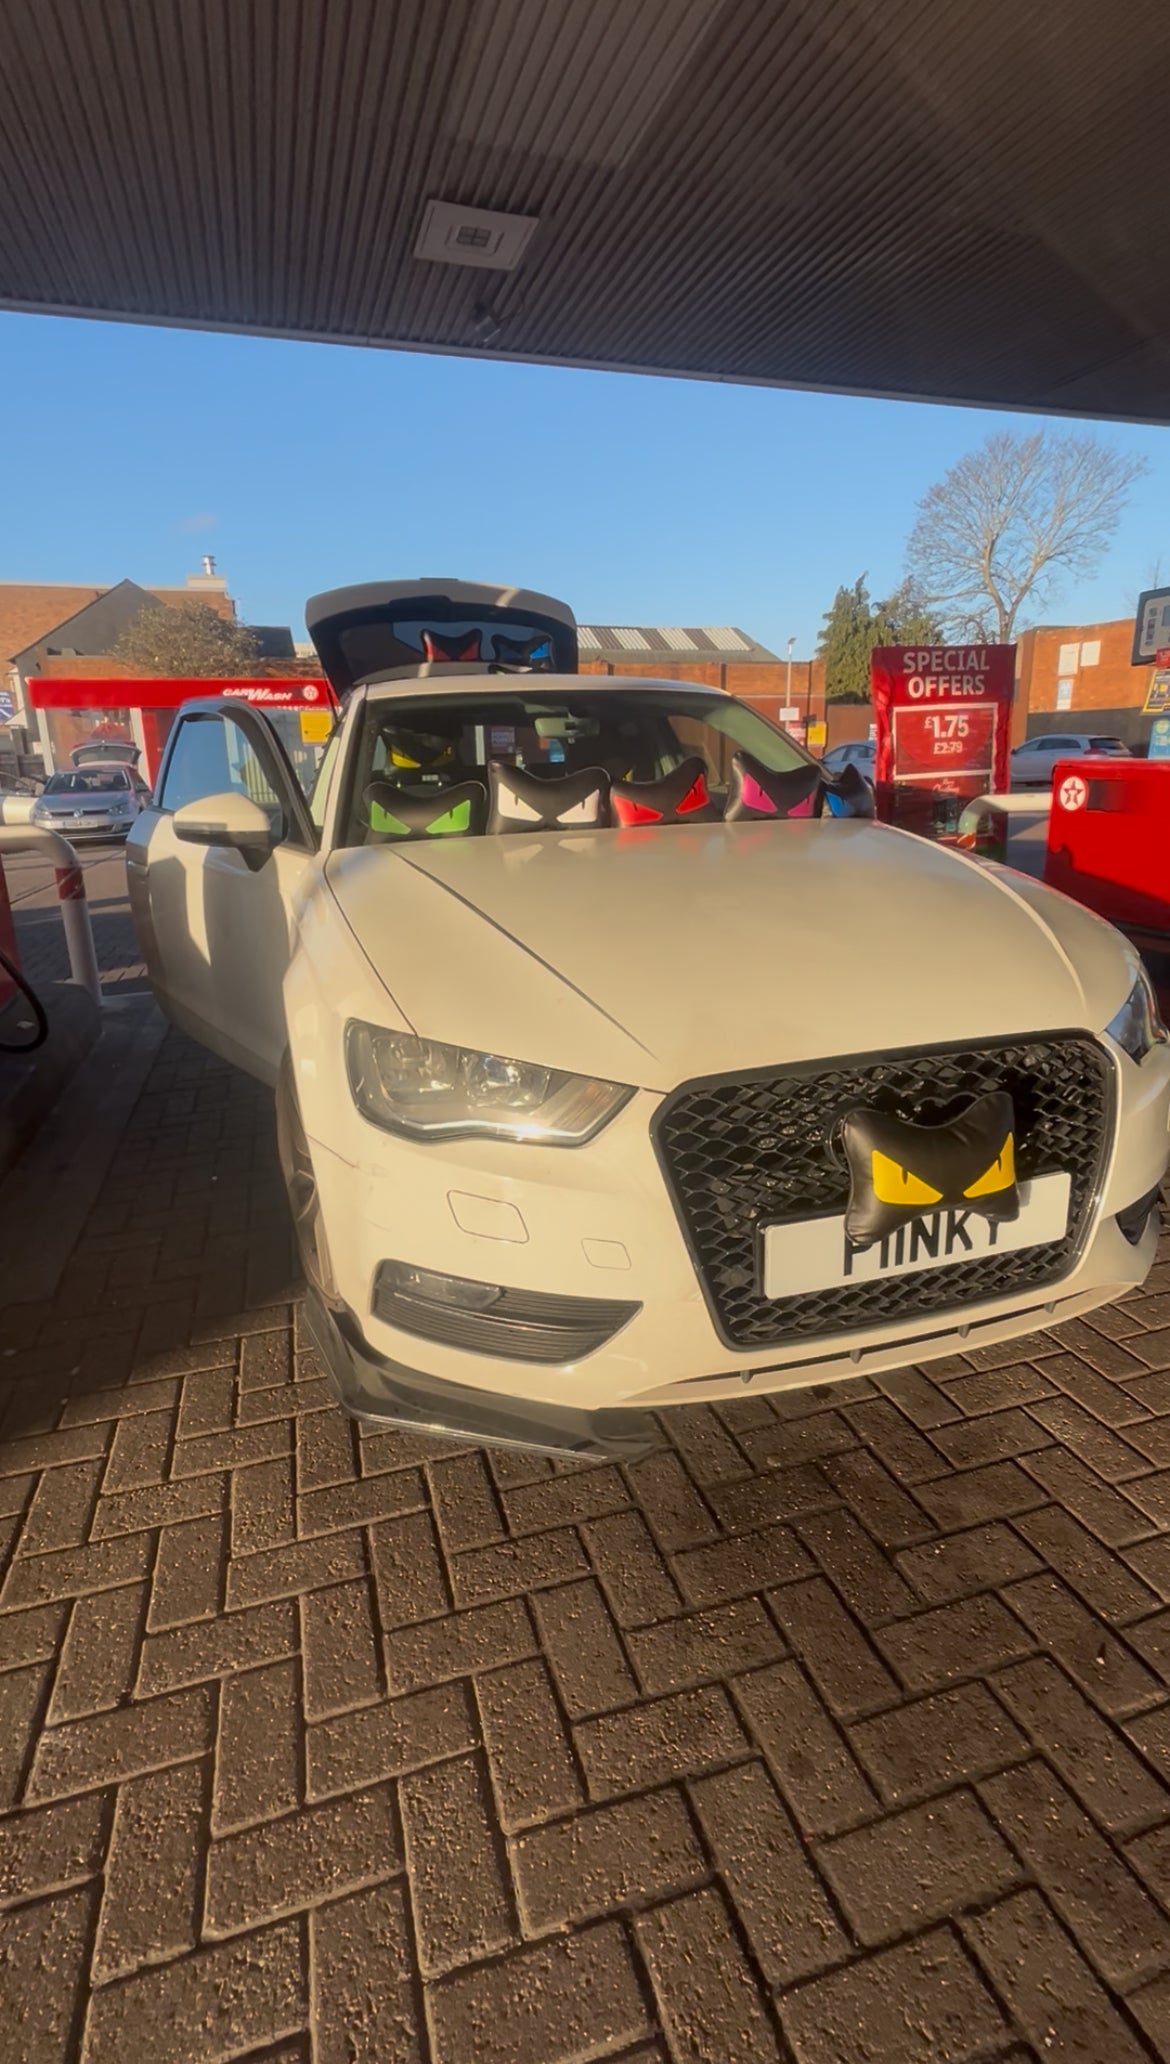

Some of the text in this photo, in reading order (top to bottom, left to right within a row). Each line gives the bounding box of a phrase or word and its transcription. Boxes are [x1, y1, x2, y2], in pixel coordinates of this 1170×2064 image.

[903, 650, 989, 673] SPECIAL
[908, 675, 984, 698] OFFERS
[924, 714, 969, 738] £1.75
